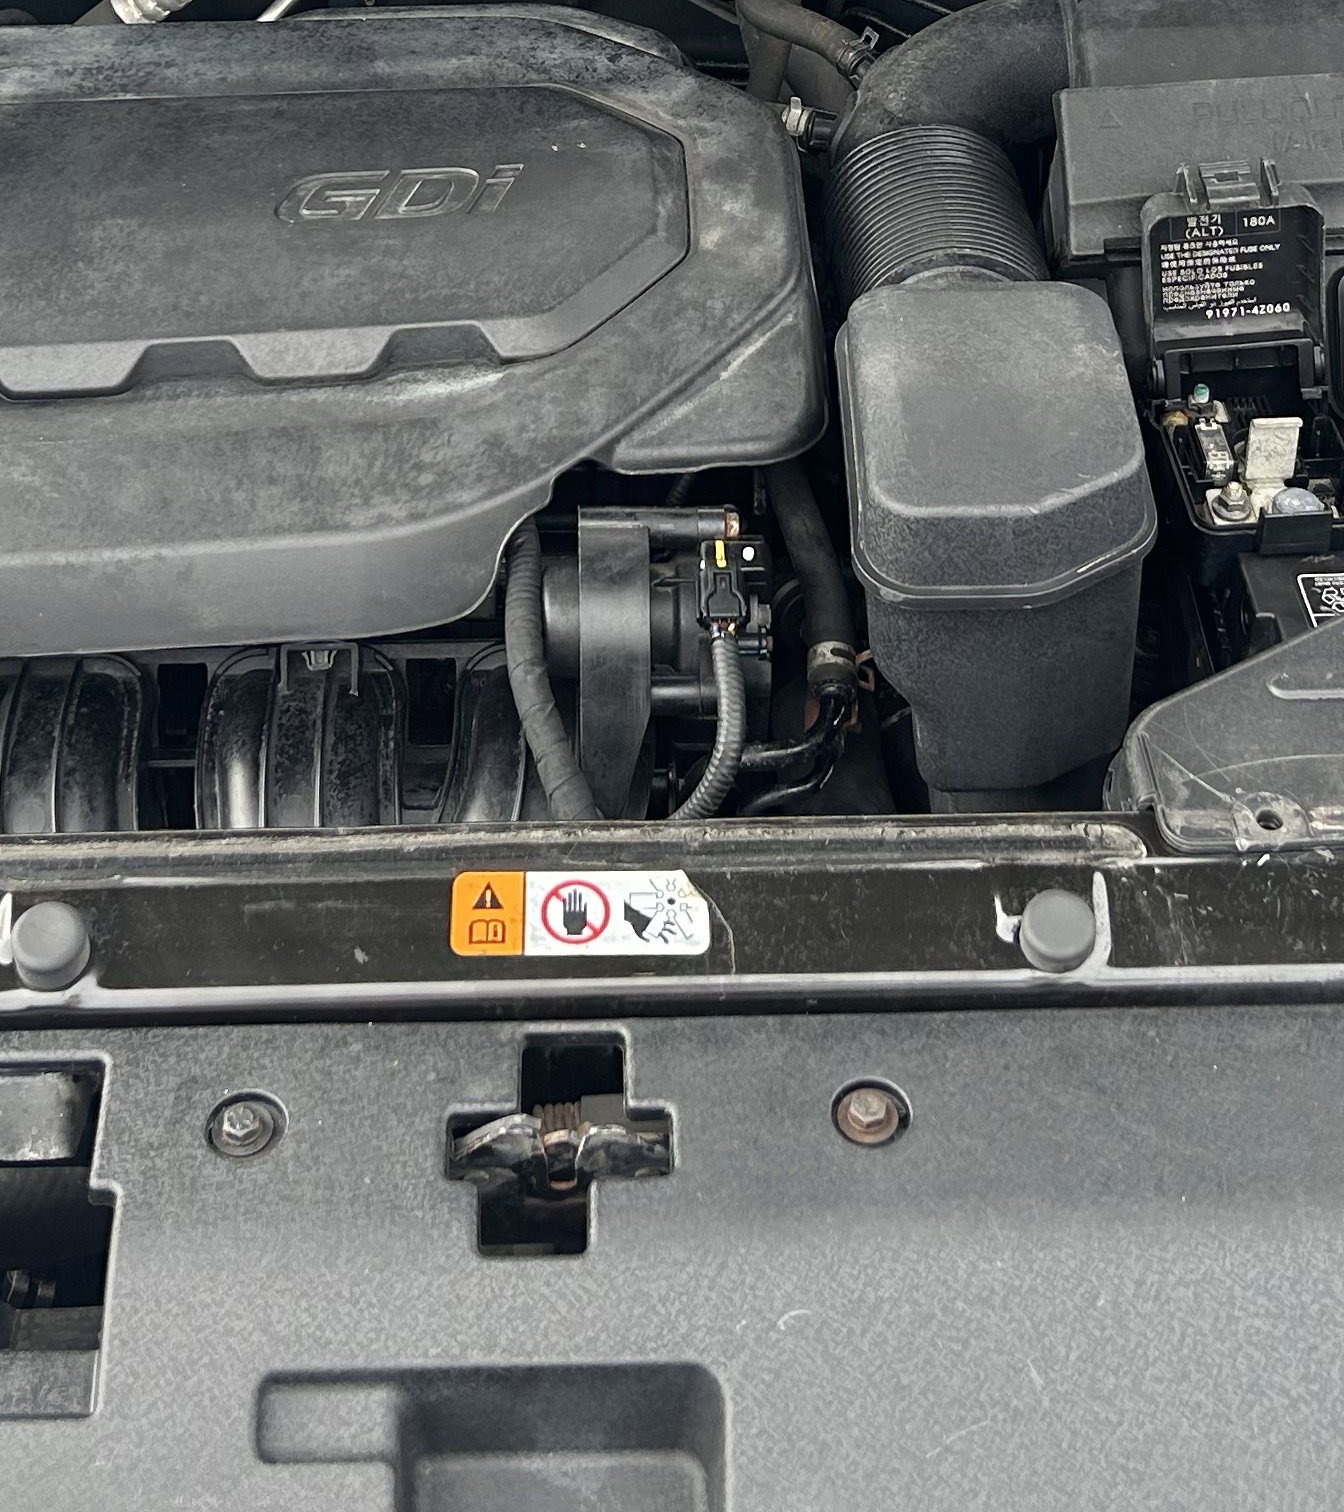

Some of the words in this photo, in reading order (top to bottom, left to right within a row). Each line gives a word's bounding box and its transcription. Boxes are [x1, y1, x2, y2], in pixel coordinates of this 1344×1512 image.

[274, 163, 525, 224] GDi
[1242, 215, 1276, 228] 180A
[1185, 226, 1224, 239] (ALT)
[1206, 302, 1291, 319] 91971-4Z060
